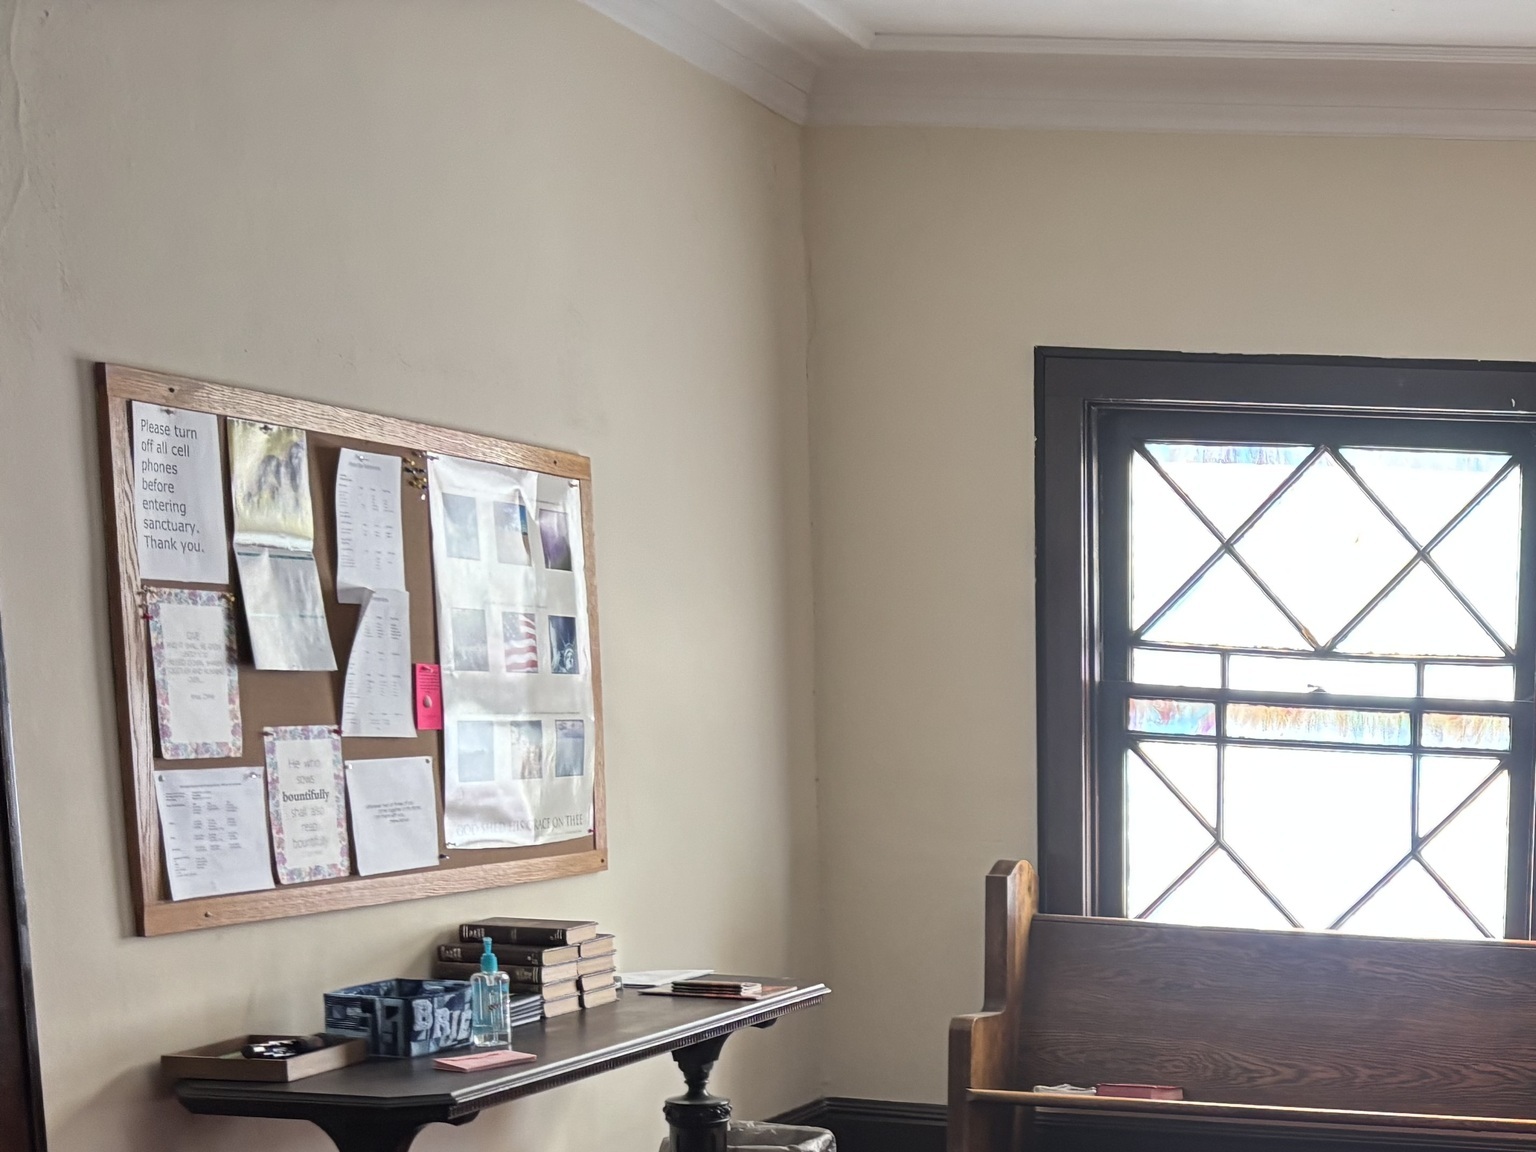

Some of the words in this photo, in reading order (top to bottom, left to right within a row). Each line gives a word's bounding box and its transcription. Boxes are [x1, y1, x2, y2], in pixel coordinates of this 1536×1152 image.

[140, 419, 171, 436] Please
[174, 424, 198, 440] turn
[141, 439, 154, 452] off
[156, 441, 168, 455] all
[171, 444, 190, 457] cell
[141, 460, 178, 475] phones
[142, 477, 175, 494] before
[142, 499, 187, 517] entering
[143, 517, 200, 536] sanctuary.
[144, 535, 178, 551] Thank
[180, 539, 205, 555] you.
[282, 789, 330, 802] bountifully
